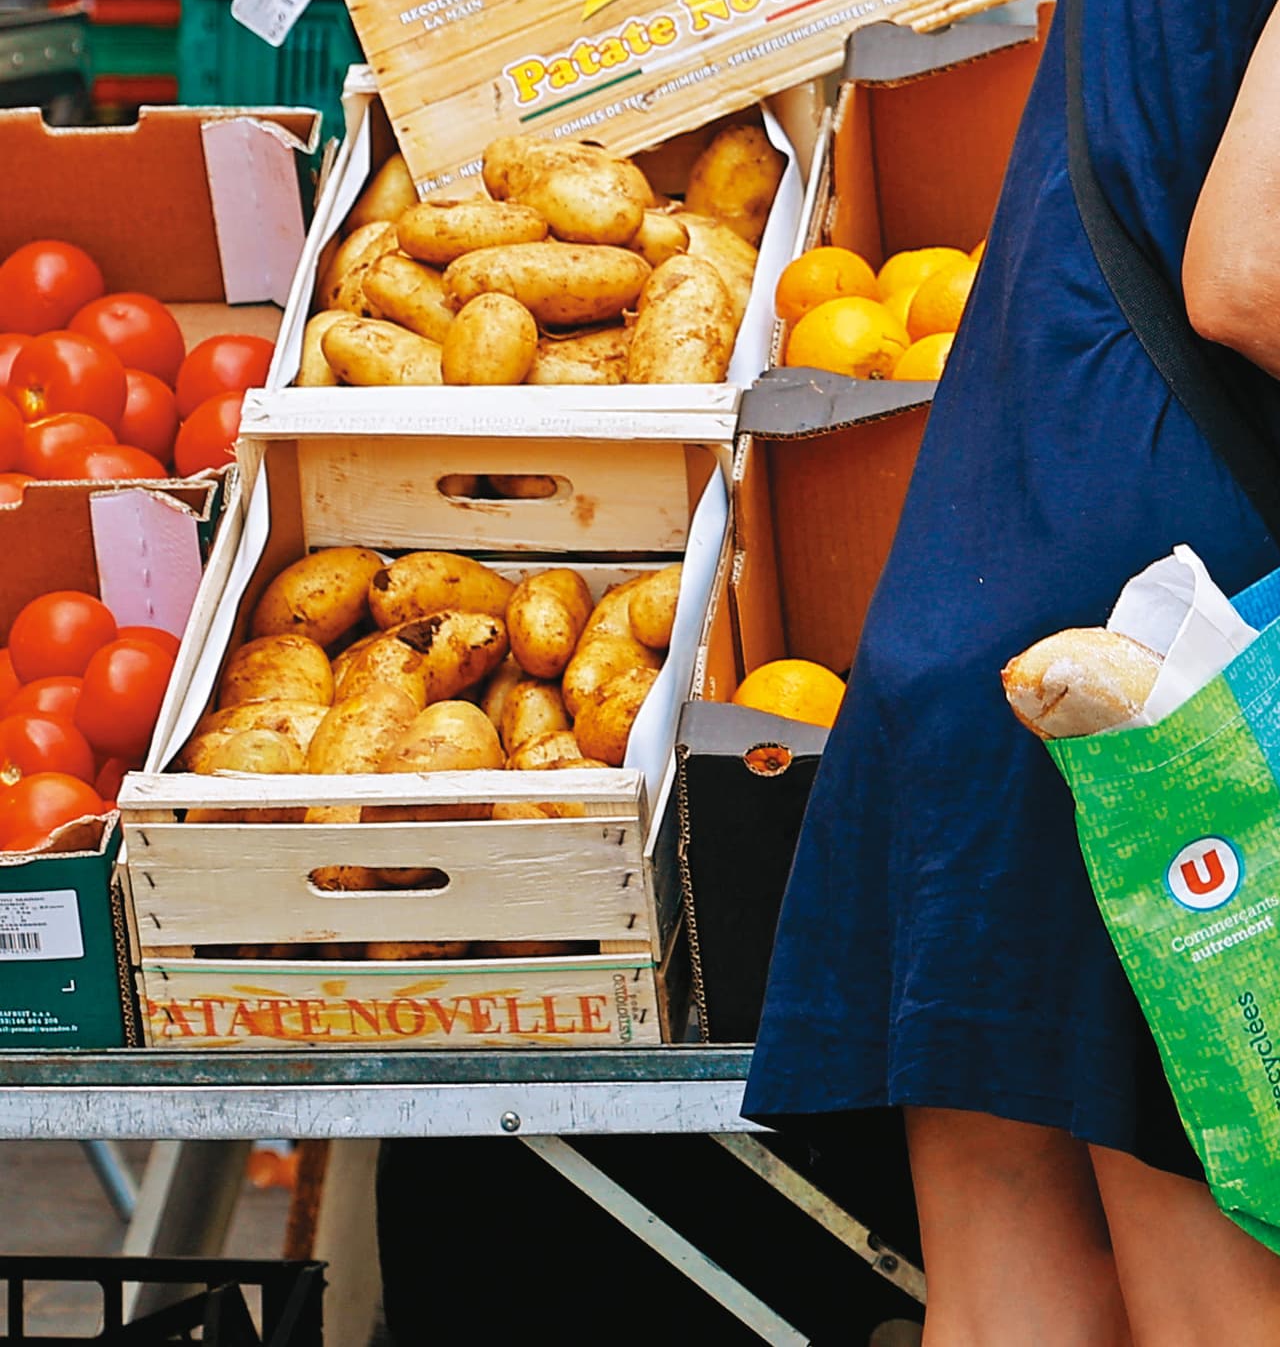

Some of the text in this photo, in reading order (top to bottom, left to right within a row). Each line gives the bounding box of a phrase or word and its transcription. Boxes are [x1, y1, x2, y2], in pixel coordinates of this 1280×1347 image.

[423, 14, 445, 30] LA
[506, 14, 676, 106] Patate
[553, 110, 605, 140] POMMES
[606, 102, 622, 118] DE
[1180, 848, 1226, 895] U
[1171, 895, 1280, 953] Commerçants
[1191, 914, 1275, 964] autrement
[345, 994, 612, 1038] NOVELLE
